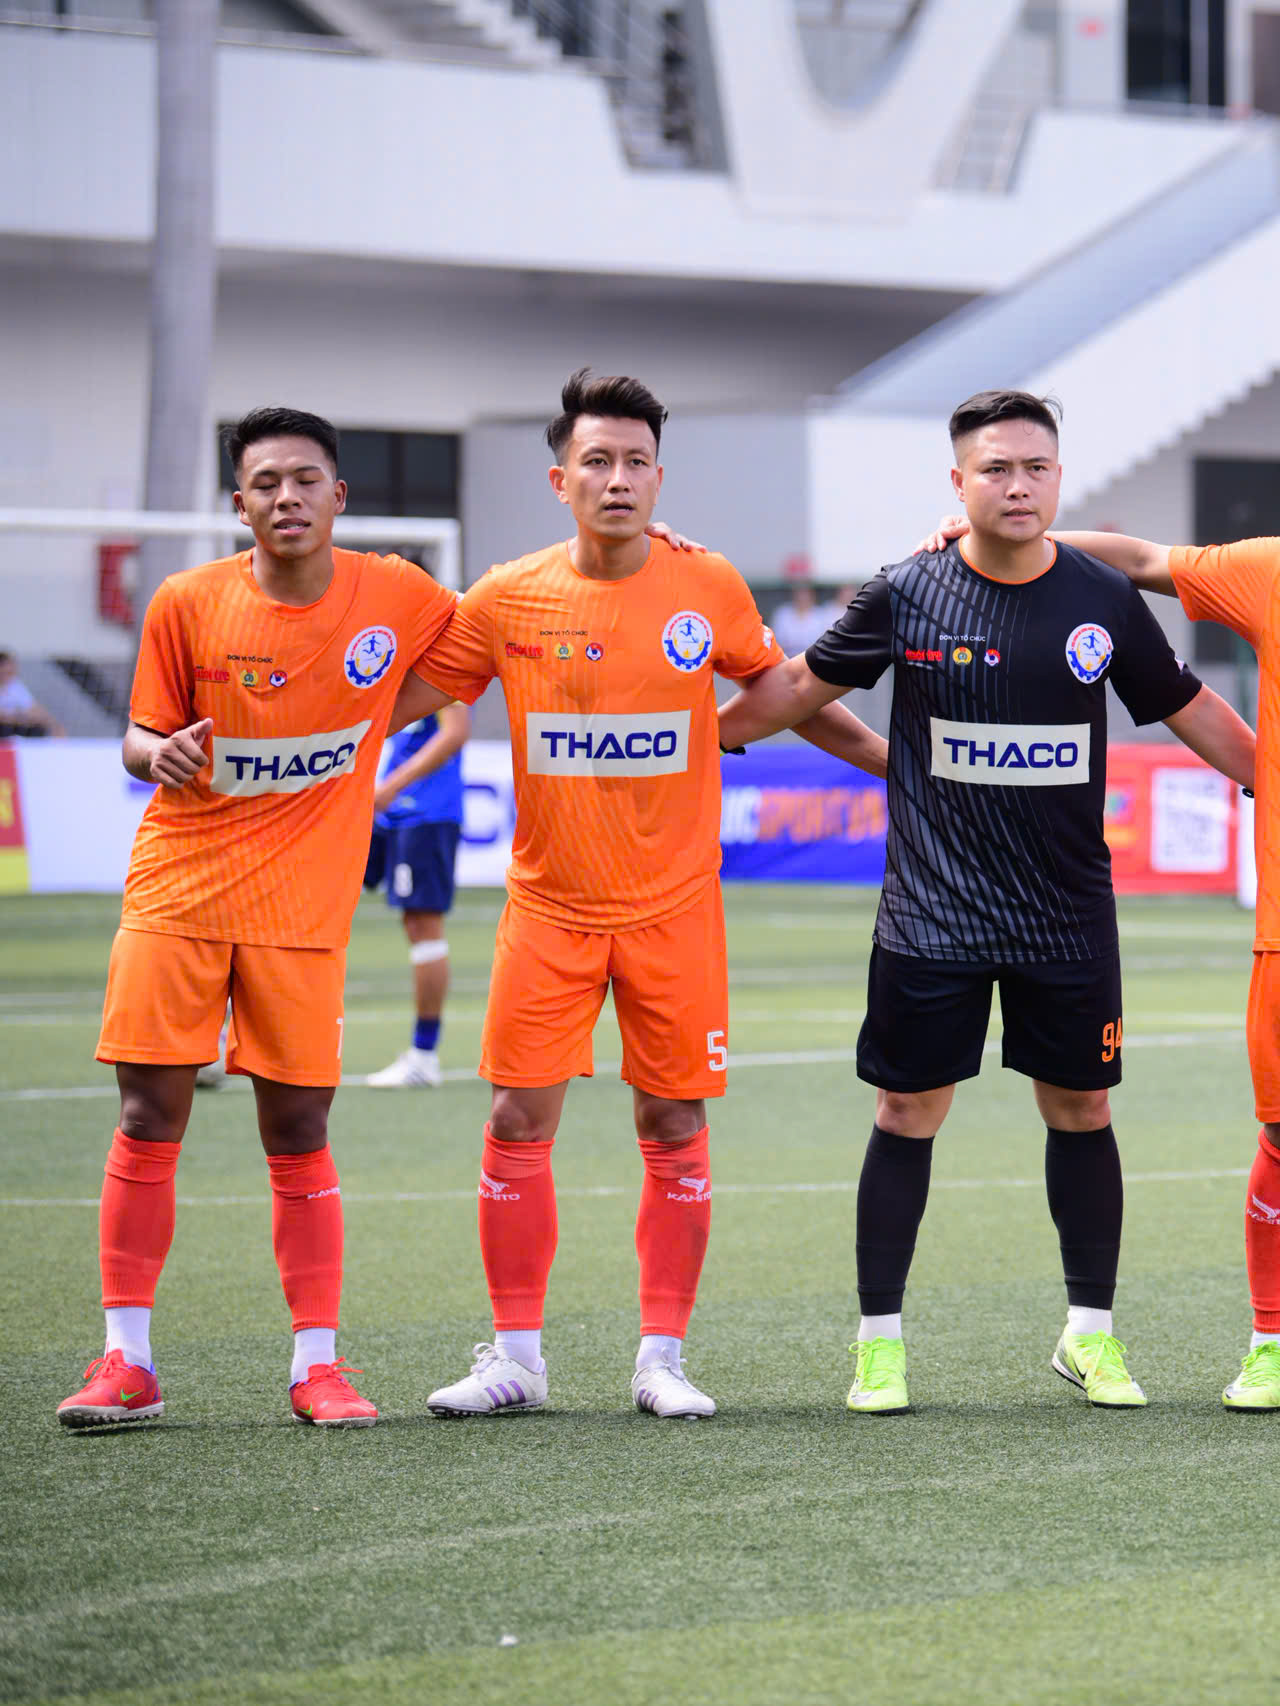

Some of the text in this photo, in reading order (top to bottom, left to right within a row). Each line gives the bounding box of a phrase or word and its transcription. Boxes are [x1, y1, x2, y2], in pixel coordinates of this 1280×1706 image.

[225, 742, 356, 781] THACO
[541, 730, 677, 760] THACO
[942, 736, 1079, 769] THACO
[707, 1030, 727, 1071] 5
[1102, 1017, 1122, 1062] 94
